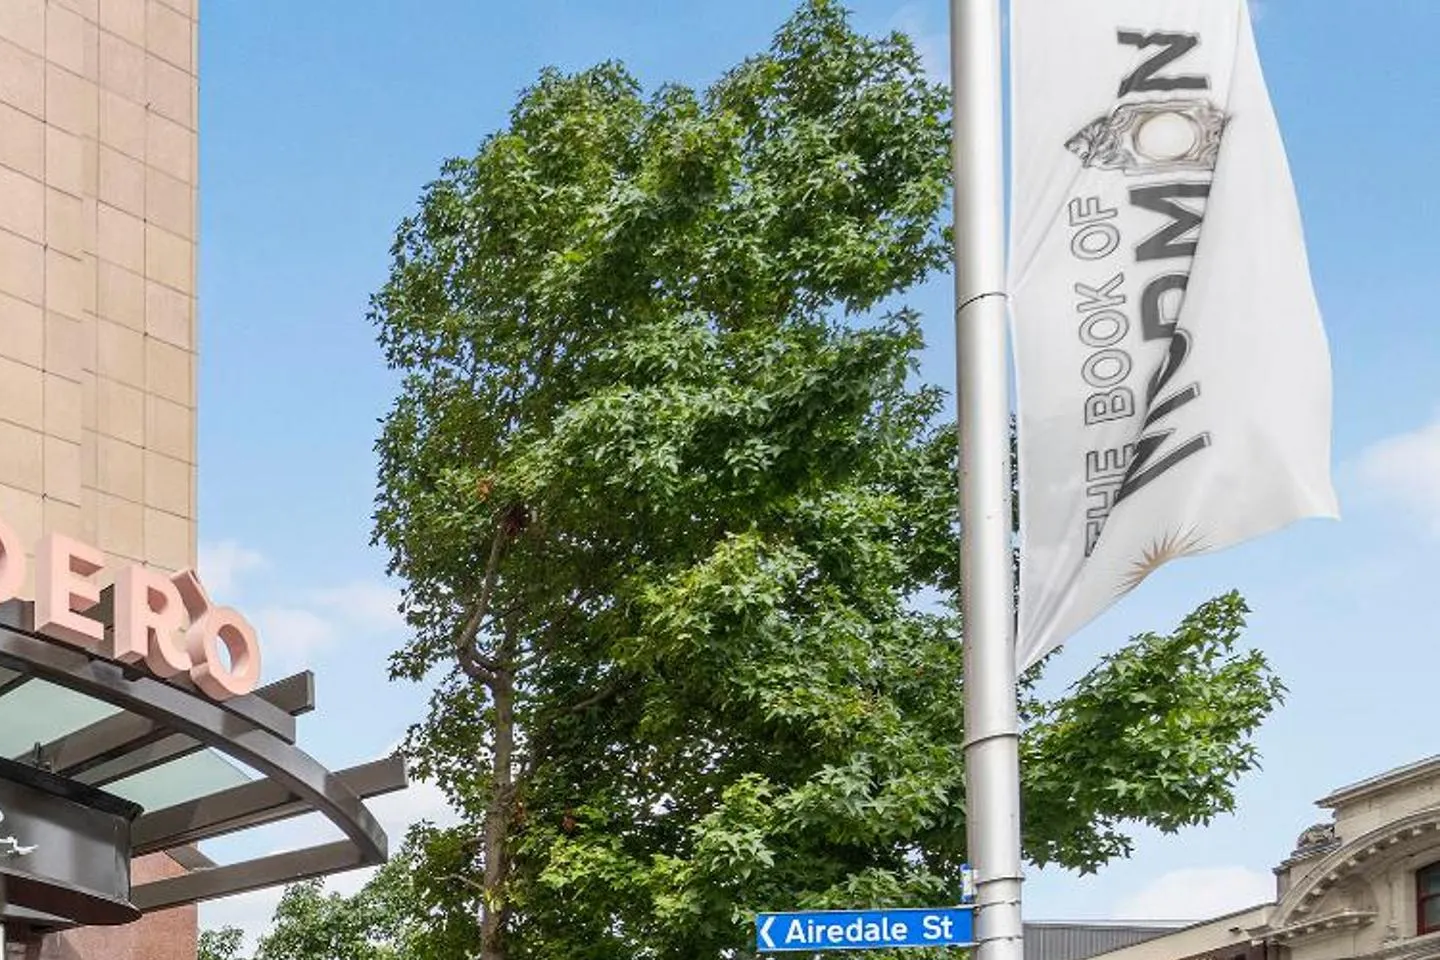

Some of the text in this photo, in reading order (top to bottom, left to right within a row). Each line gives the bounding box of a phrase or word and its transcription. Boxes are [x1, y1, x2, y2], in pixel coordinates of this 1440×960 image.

[1068, 196, 1121, 261] OF
[1074, 272, 1136, 426] BOOK
[784, 914, 954, 944] Airedale St
